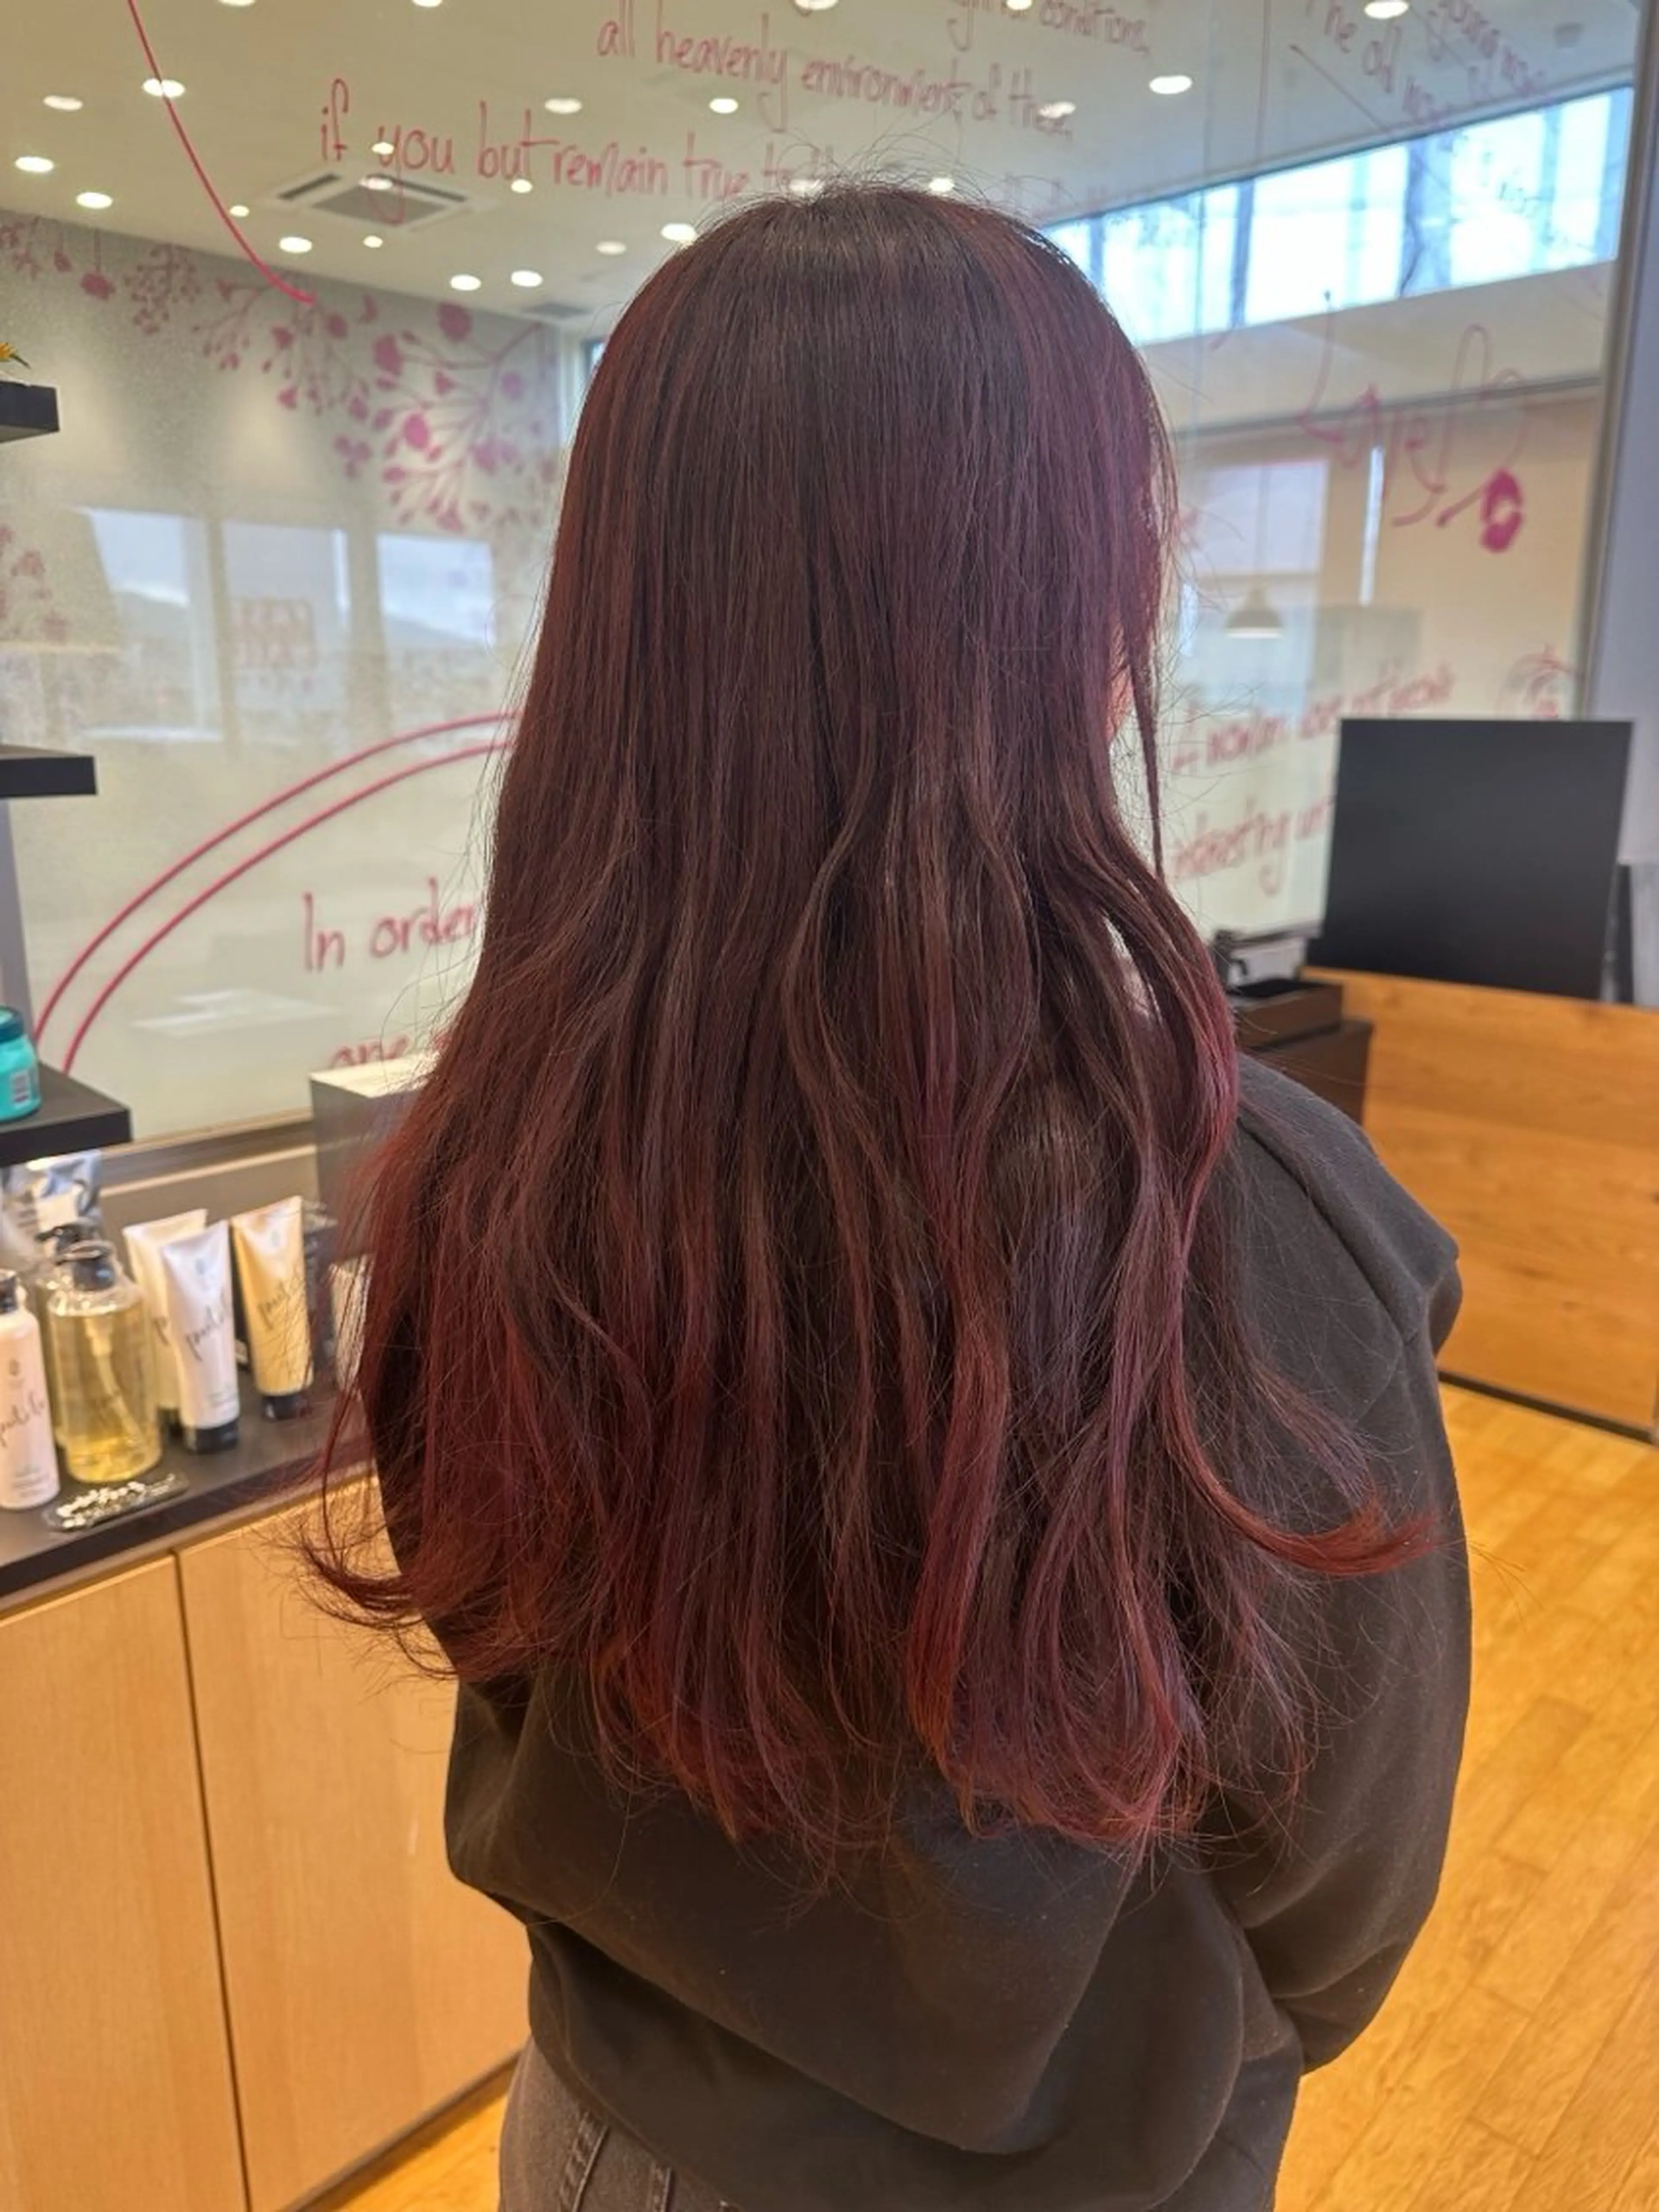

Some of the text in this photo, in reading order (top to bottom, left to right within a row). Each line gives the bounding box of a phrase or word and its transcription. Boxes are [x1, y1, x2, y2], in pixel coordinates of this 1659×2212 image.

[597, 0, 634, 58] all
[655, 0, 787, 133] heavenly
[321, 78, 348, 162] if
[377, 125, 455, 225] you
[478, 101, 560, 179] but
[553, 142, 668, 199] remain
[302, 891, 346, 973] In
